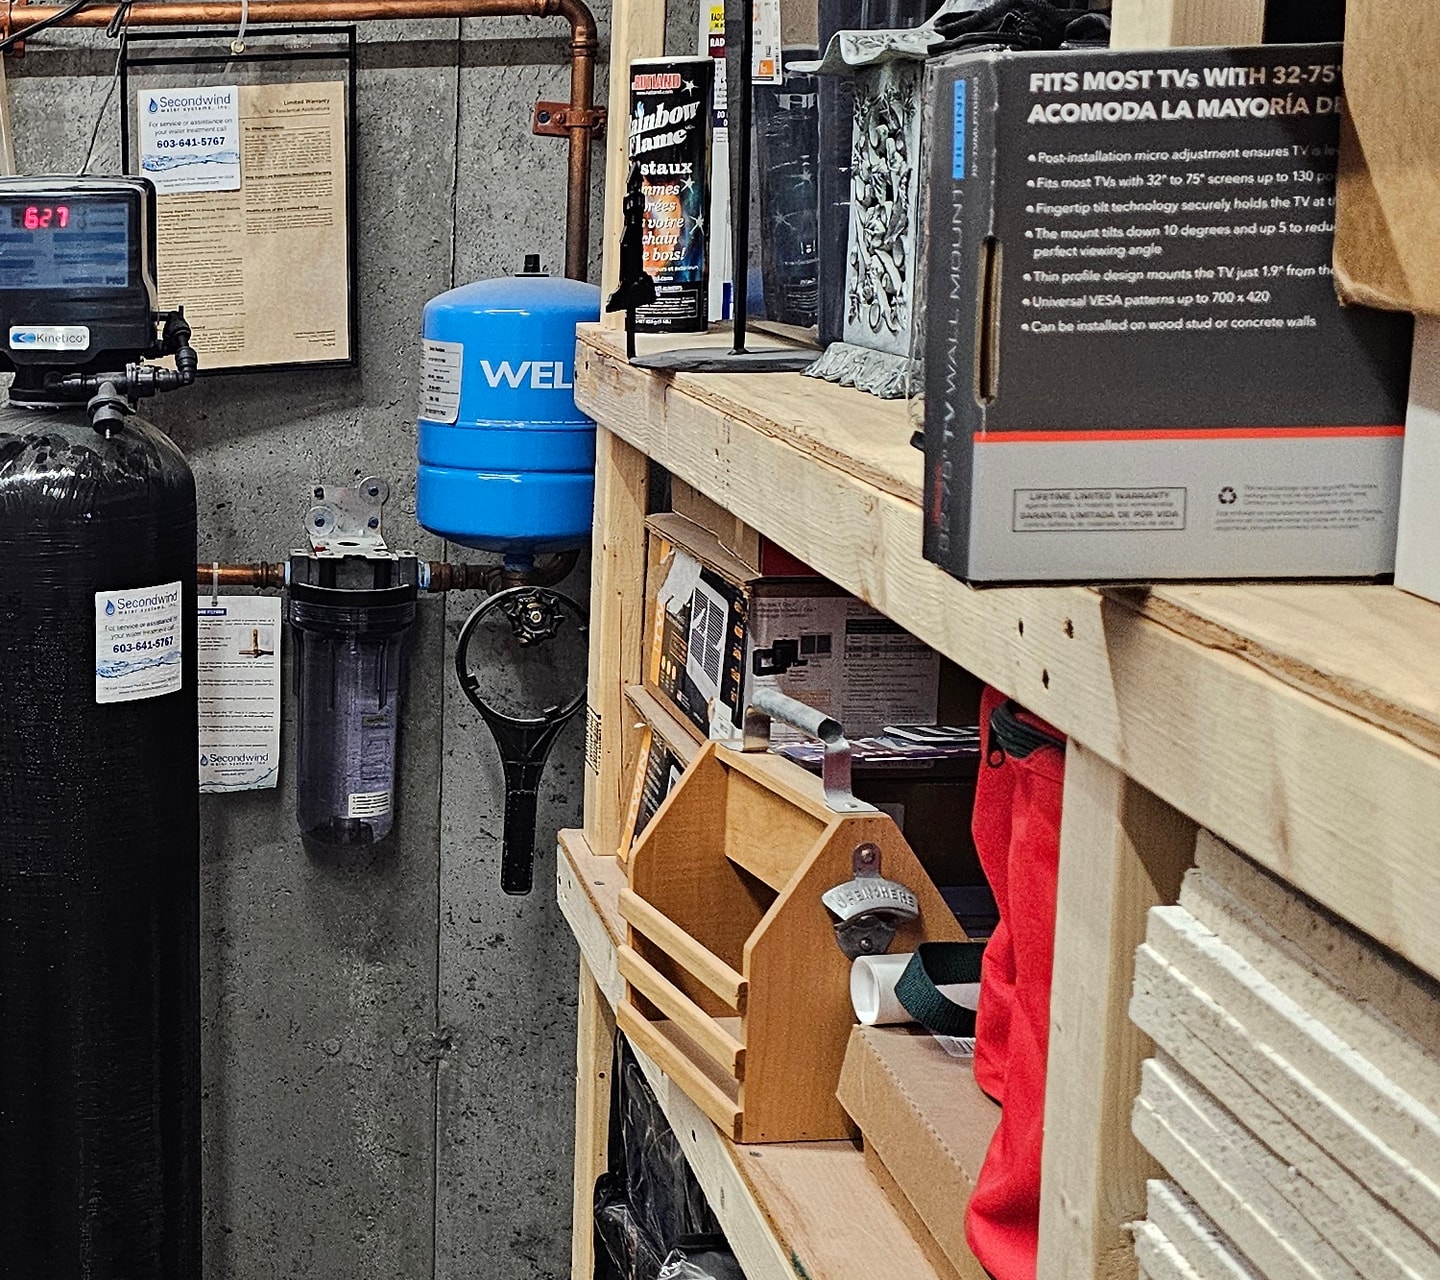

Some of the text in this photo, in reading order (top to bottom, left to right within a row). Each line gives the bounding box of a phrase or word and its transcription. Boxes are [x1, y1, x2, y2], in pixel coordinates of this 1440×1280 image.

[1030, 73, 1079, 92] FITS
[1083, 70, 1154, 91] MOST
[1157, 69, 1200, 88] TVs
[1203, 67, 1266, 87] WITH
[160, 93, 231, 108] Secondwind
[1027, 100, 1158, 124] ACOMODA
[1162, 100, 1194, 119] LA
[1197, 92, 1312, 119] MAYORÍA
[629, 101, 700, 137] ainbow
[156, 136, 225, 149] 603-641-5767
[1038, 147, 1289, 164] Post-installation micro adjustment ensures
[640, 161, 692, 175] staux
[1037, 170, 1314, 190] Fits most TVs with 32" to 75" screens up to 130
[1036, 196, 1326, 216] Fingertip tilt technology securely holds the TV at
[1035, 220, 1334, 239] The mount tilts down 10 degrees and up 5 redu
[951, 189, 964, 299] MOUNT
[1033, 243, 1163, 259] perfect viewing angle
[653, 248, 686, 261] bois!
[1033, 270, 1059, 282] Thin
[1062, 269, 1100, 283] profile
[1102, 268, 1144, 281] design
[1147, 267, 1192, 279] mounts
[1194, 266, 1215, 278] the
[1216, 266, 1234, 277] TV
[1235, 265, 1259, 278] just
[1262, 265, 1284, 276] 1.9"
[1286, 264, 1315, 276] from
[1032, 291, 1270, 308] Universal VESA patterns up to 700 420
[1031, 315, 1316, 332] Can be installed on wood stud concrete walls
[36, 331, 84, 343] Kinetico
[946, 308, 959, 394] WALL
[480, 360, 573, 389] WEL
[1029, 491, 1170, 500] LIFETIME LIMITED WARRANTY
[117, 590, 178, 610] Secondwind
[113, 636, 174, 653] 603-641-5767
[210, 753, 269, 762] Secondwind
